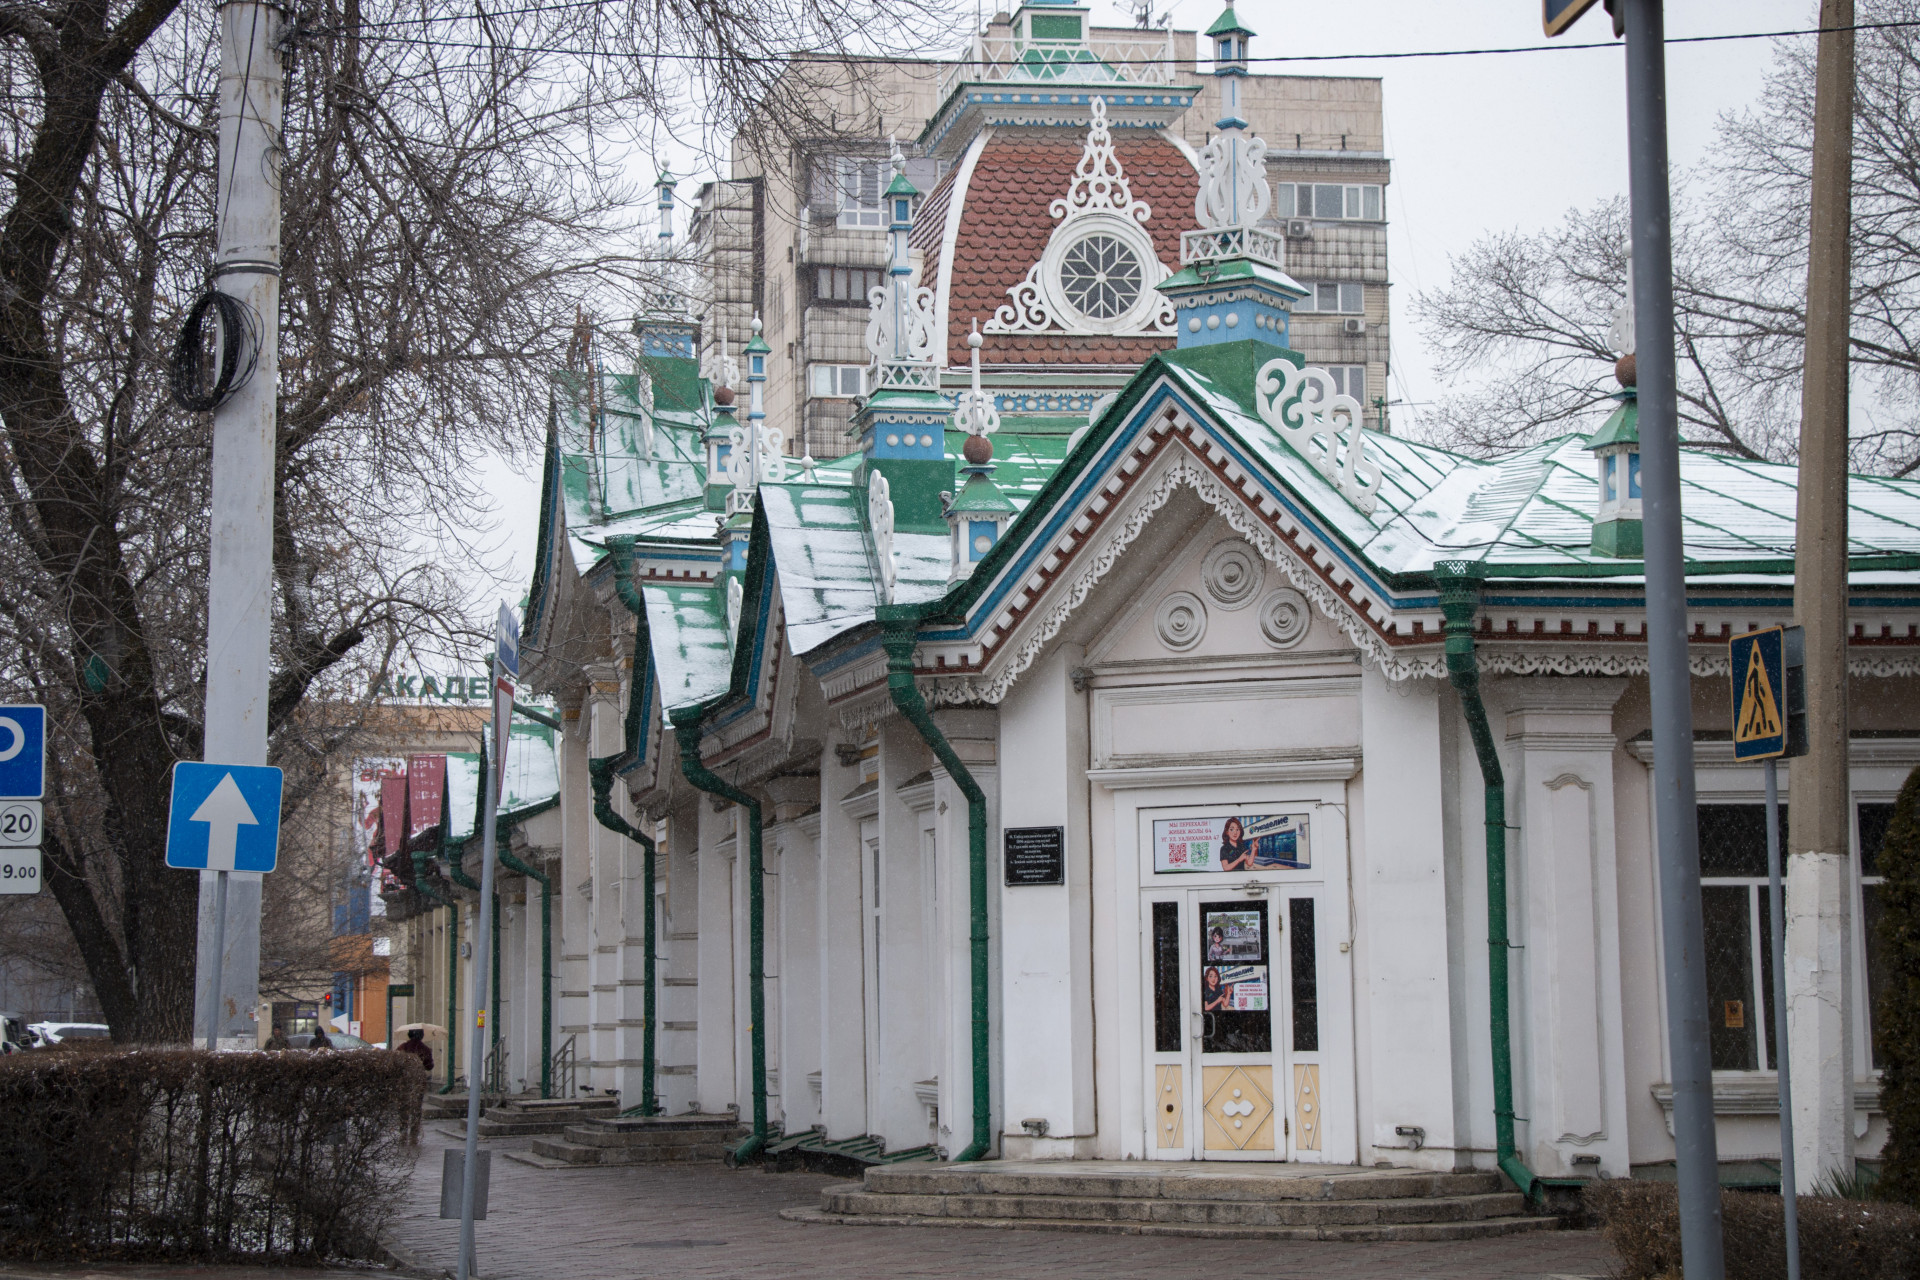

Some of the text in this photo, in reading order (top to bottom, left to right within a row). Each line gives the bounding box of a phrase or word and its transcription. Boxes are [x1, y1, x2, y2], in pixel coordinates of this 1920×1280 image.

[374, 674, 493, 703] АКАДЕ
[3, 813, 32, 834] 20
[0, 863, 37, 879] 9.00
